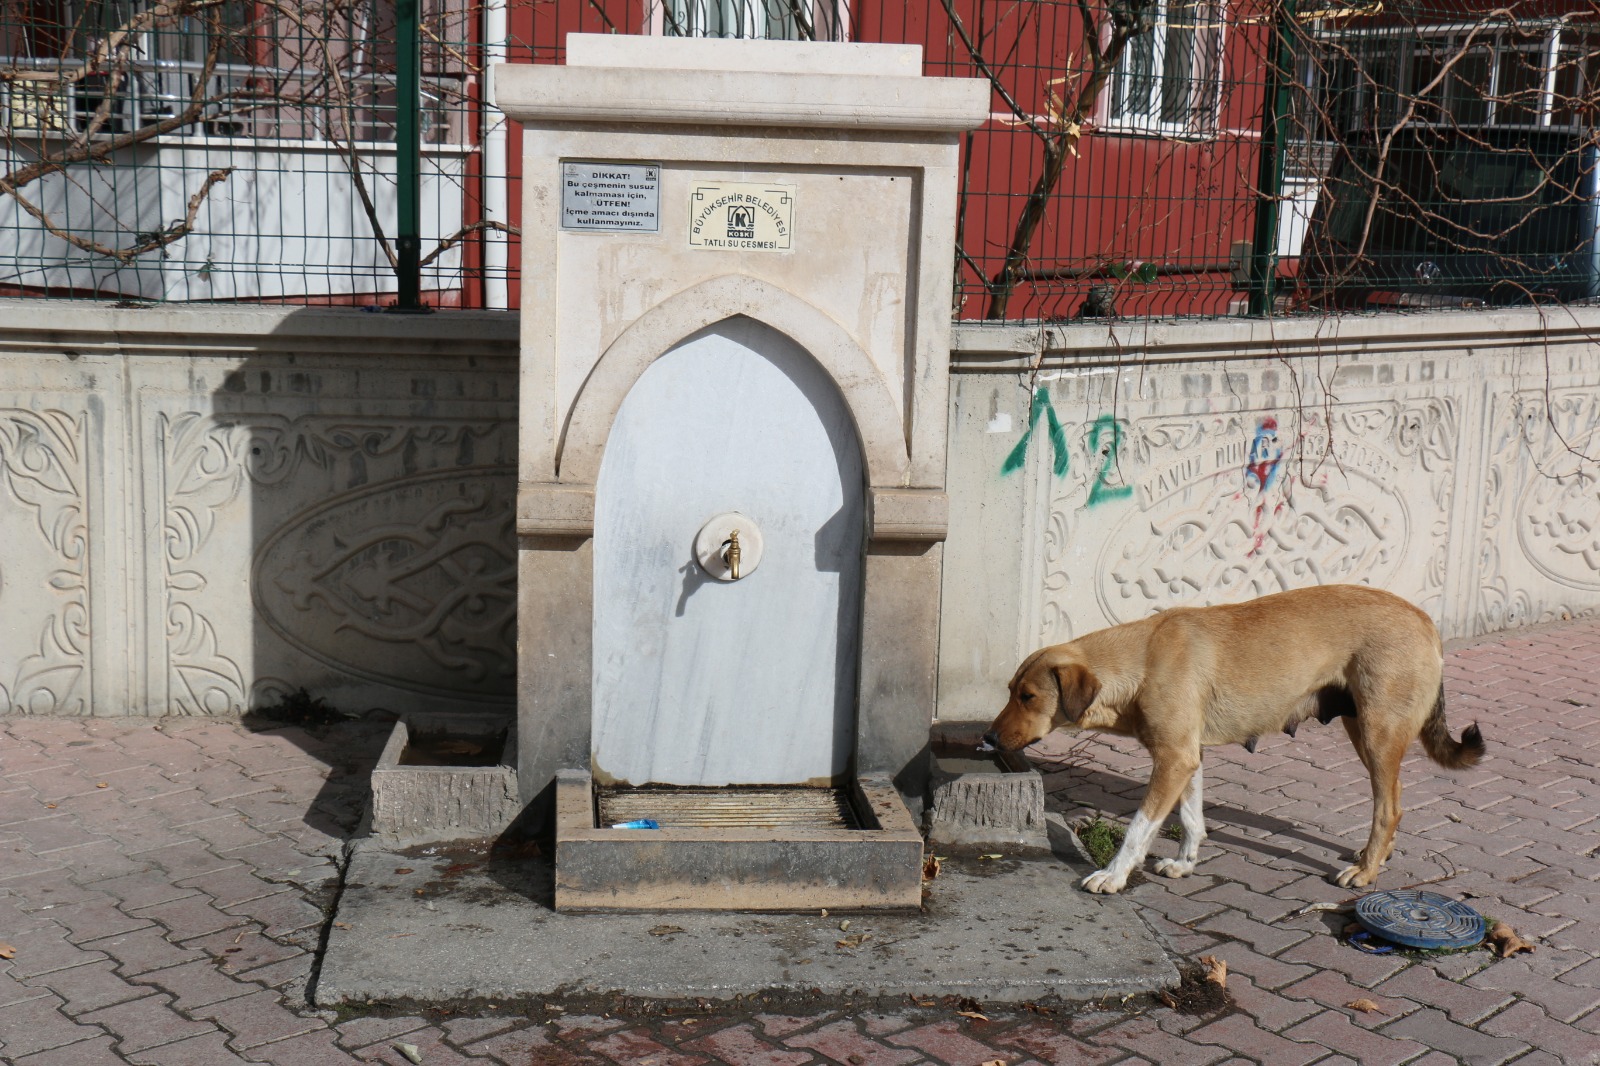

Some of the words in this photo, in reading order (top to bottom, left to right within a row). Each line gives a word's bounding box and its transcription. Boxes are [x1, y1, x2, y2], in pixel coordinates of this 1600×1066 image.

[592, 172, 630, 180] DİKKAT!
[582, 182, 626, 190] çeşmenin
[566, 207, 588, 215] İçme
[622, 210, 655, 218] dışında
[693, 192, 743, 235] BÜYÜKŞEHİR
[745, 194, 788, 237] BELEDİYESİ
[577, 218, 643, 227] kullanmayınız.
[704, 238, 726, 247] TATLI
[1143, 455, 1203, 503] YAVUZ
